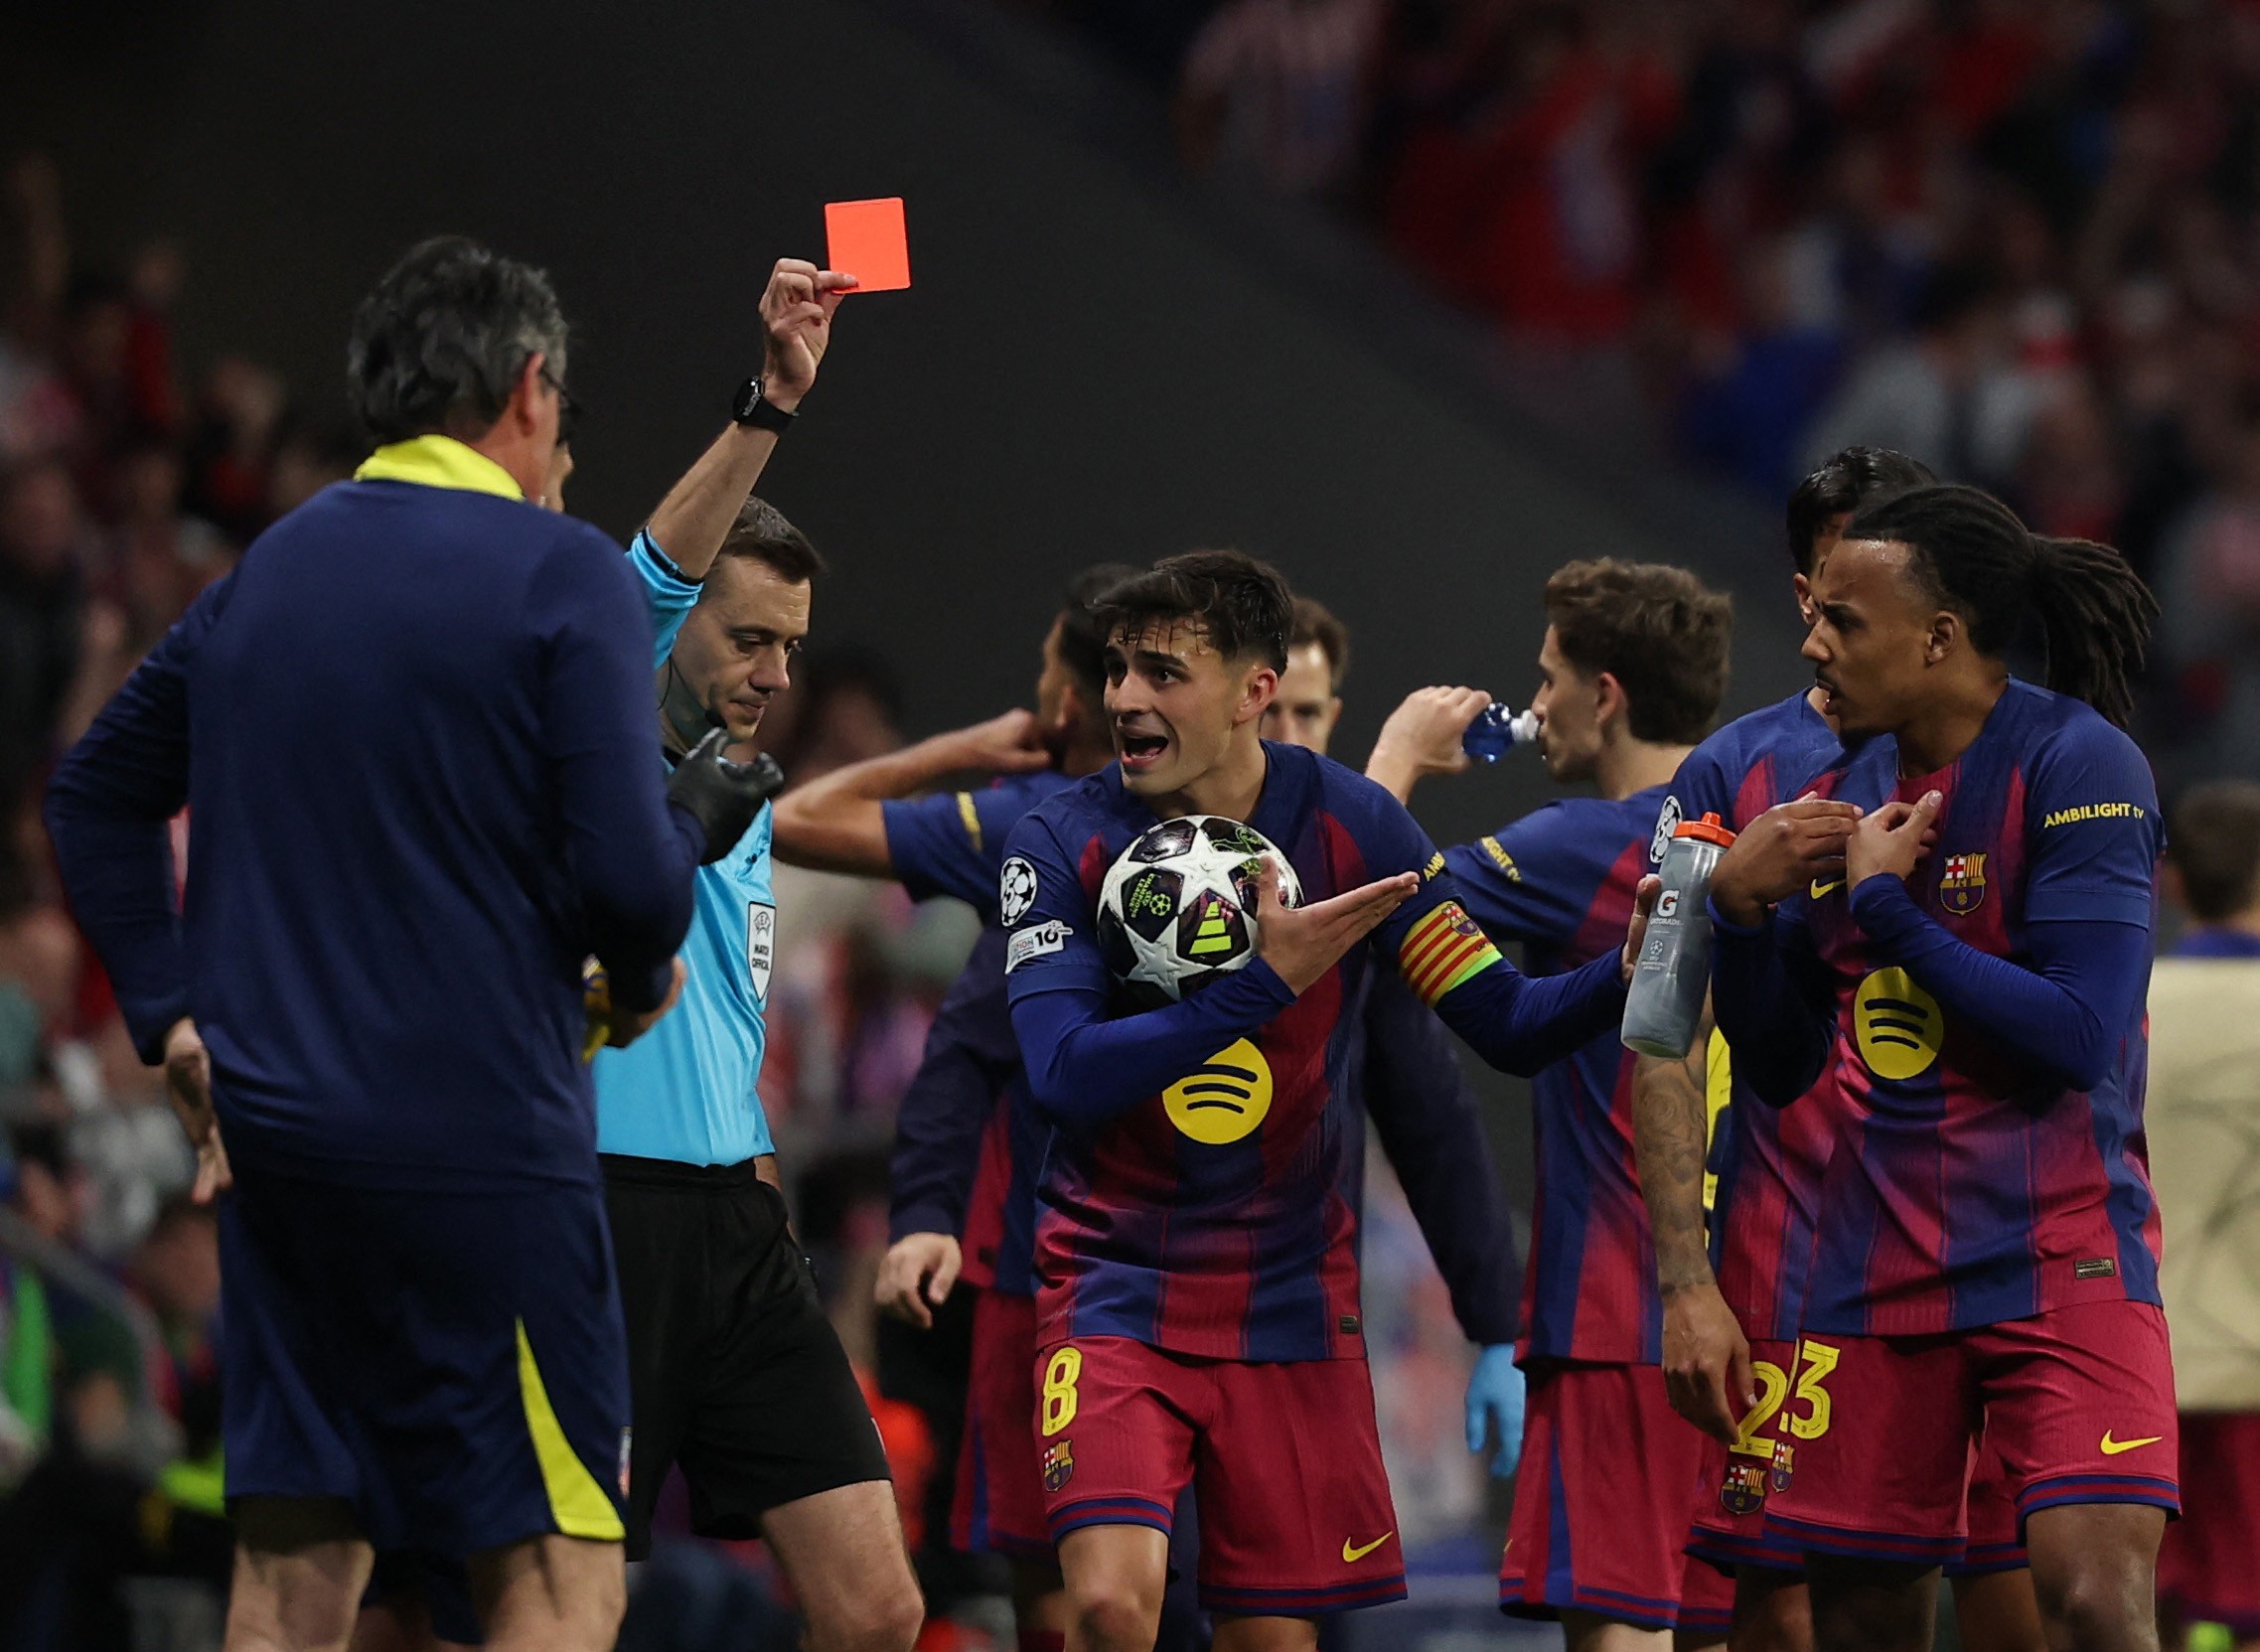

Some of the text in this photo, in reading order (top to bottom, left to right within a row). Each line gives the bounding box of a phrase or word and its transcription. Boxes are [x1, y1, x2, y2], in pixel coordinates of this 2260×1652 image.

[2044, 803, 2144, 827] AMBILIGHT tv
[1657, 890, 1680, 917] G
[1042, 1347, 1082, 1436] 8
